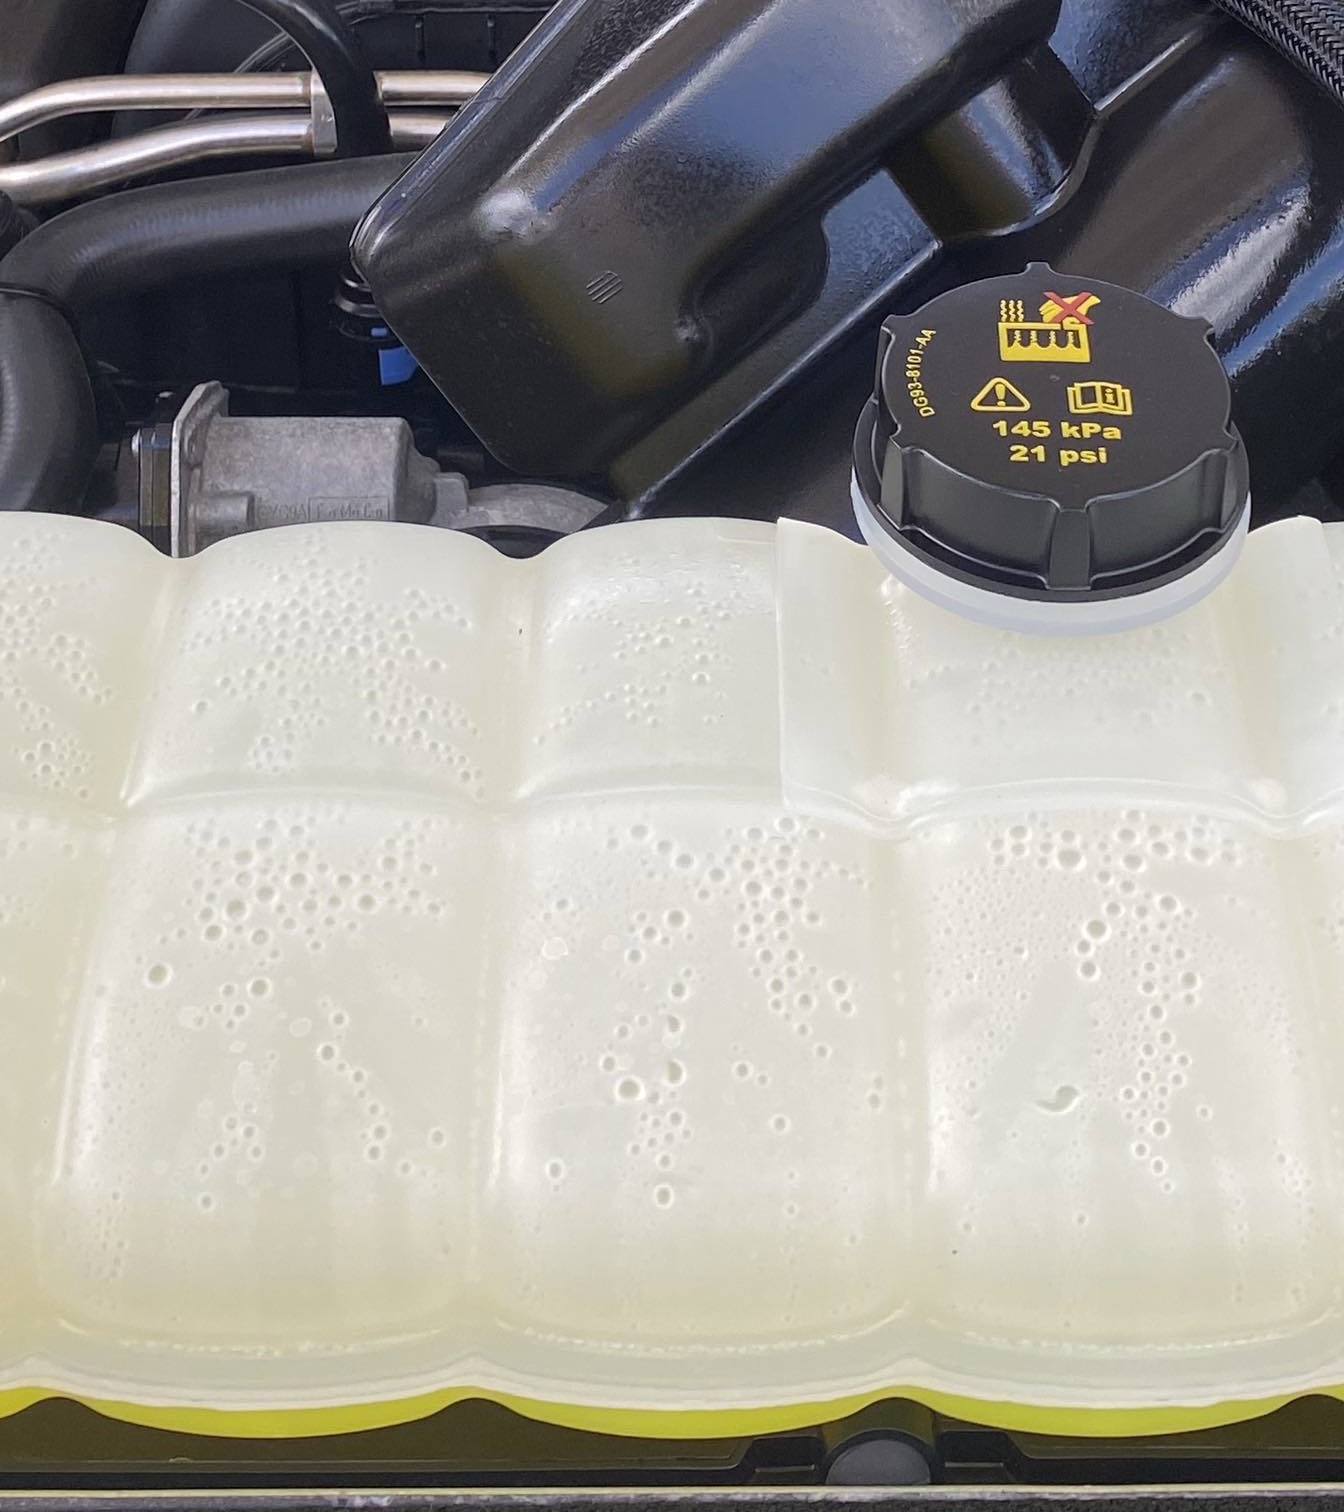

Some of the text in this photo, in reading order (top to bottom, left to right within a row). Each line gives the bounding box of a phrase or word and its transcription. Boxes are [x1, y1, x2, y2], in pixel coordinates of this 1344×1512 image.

[905, 328, 937, 418] DG93-8101-AA
[992, 420, 1122, 440] 145 kPa
[1009, 444, 1108, 467] 21 psi
